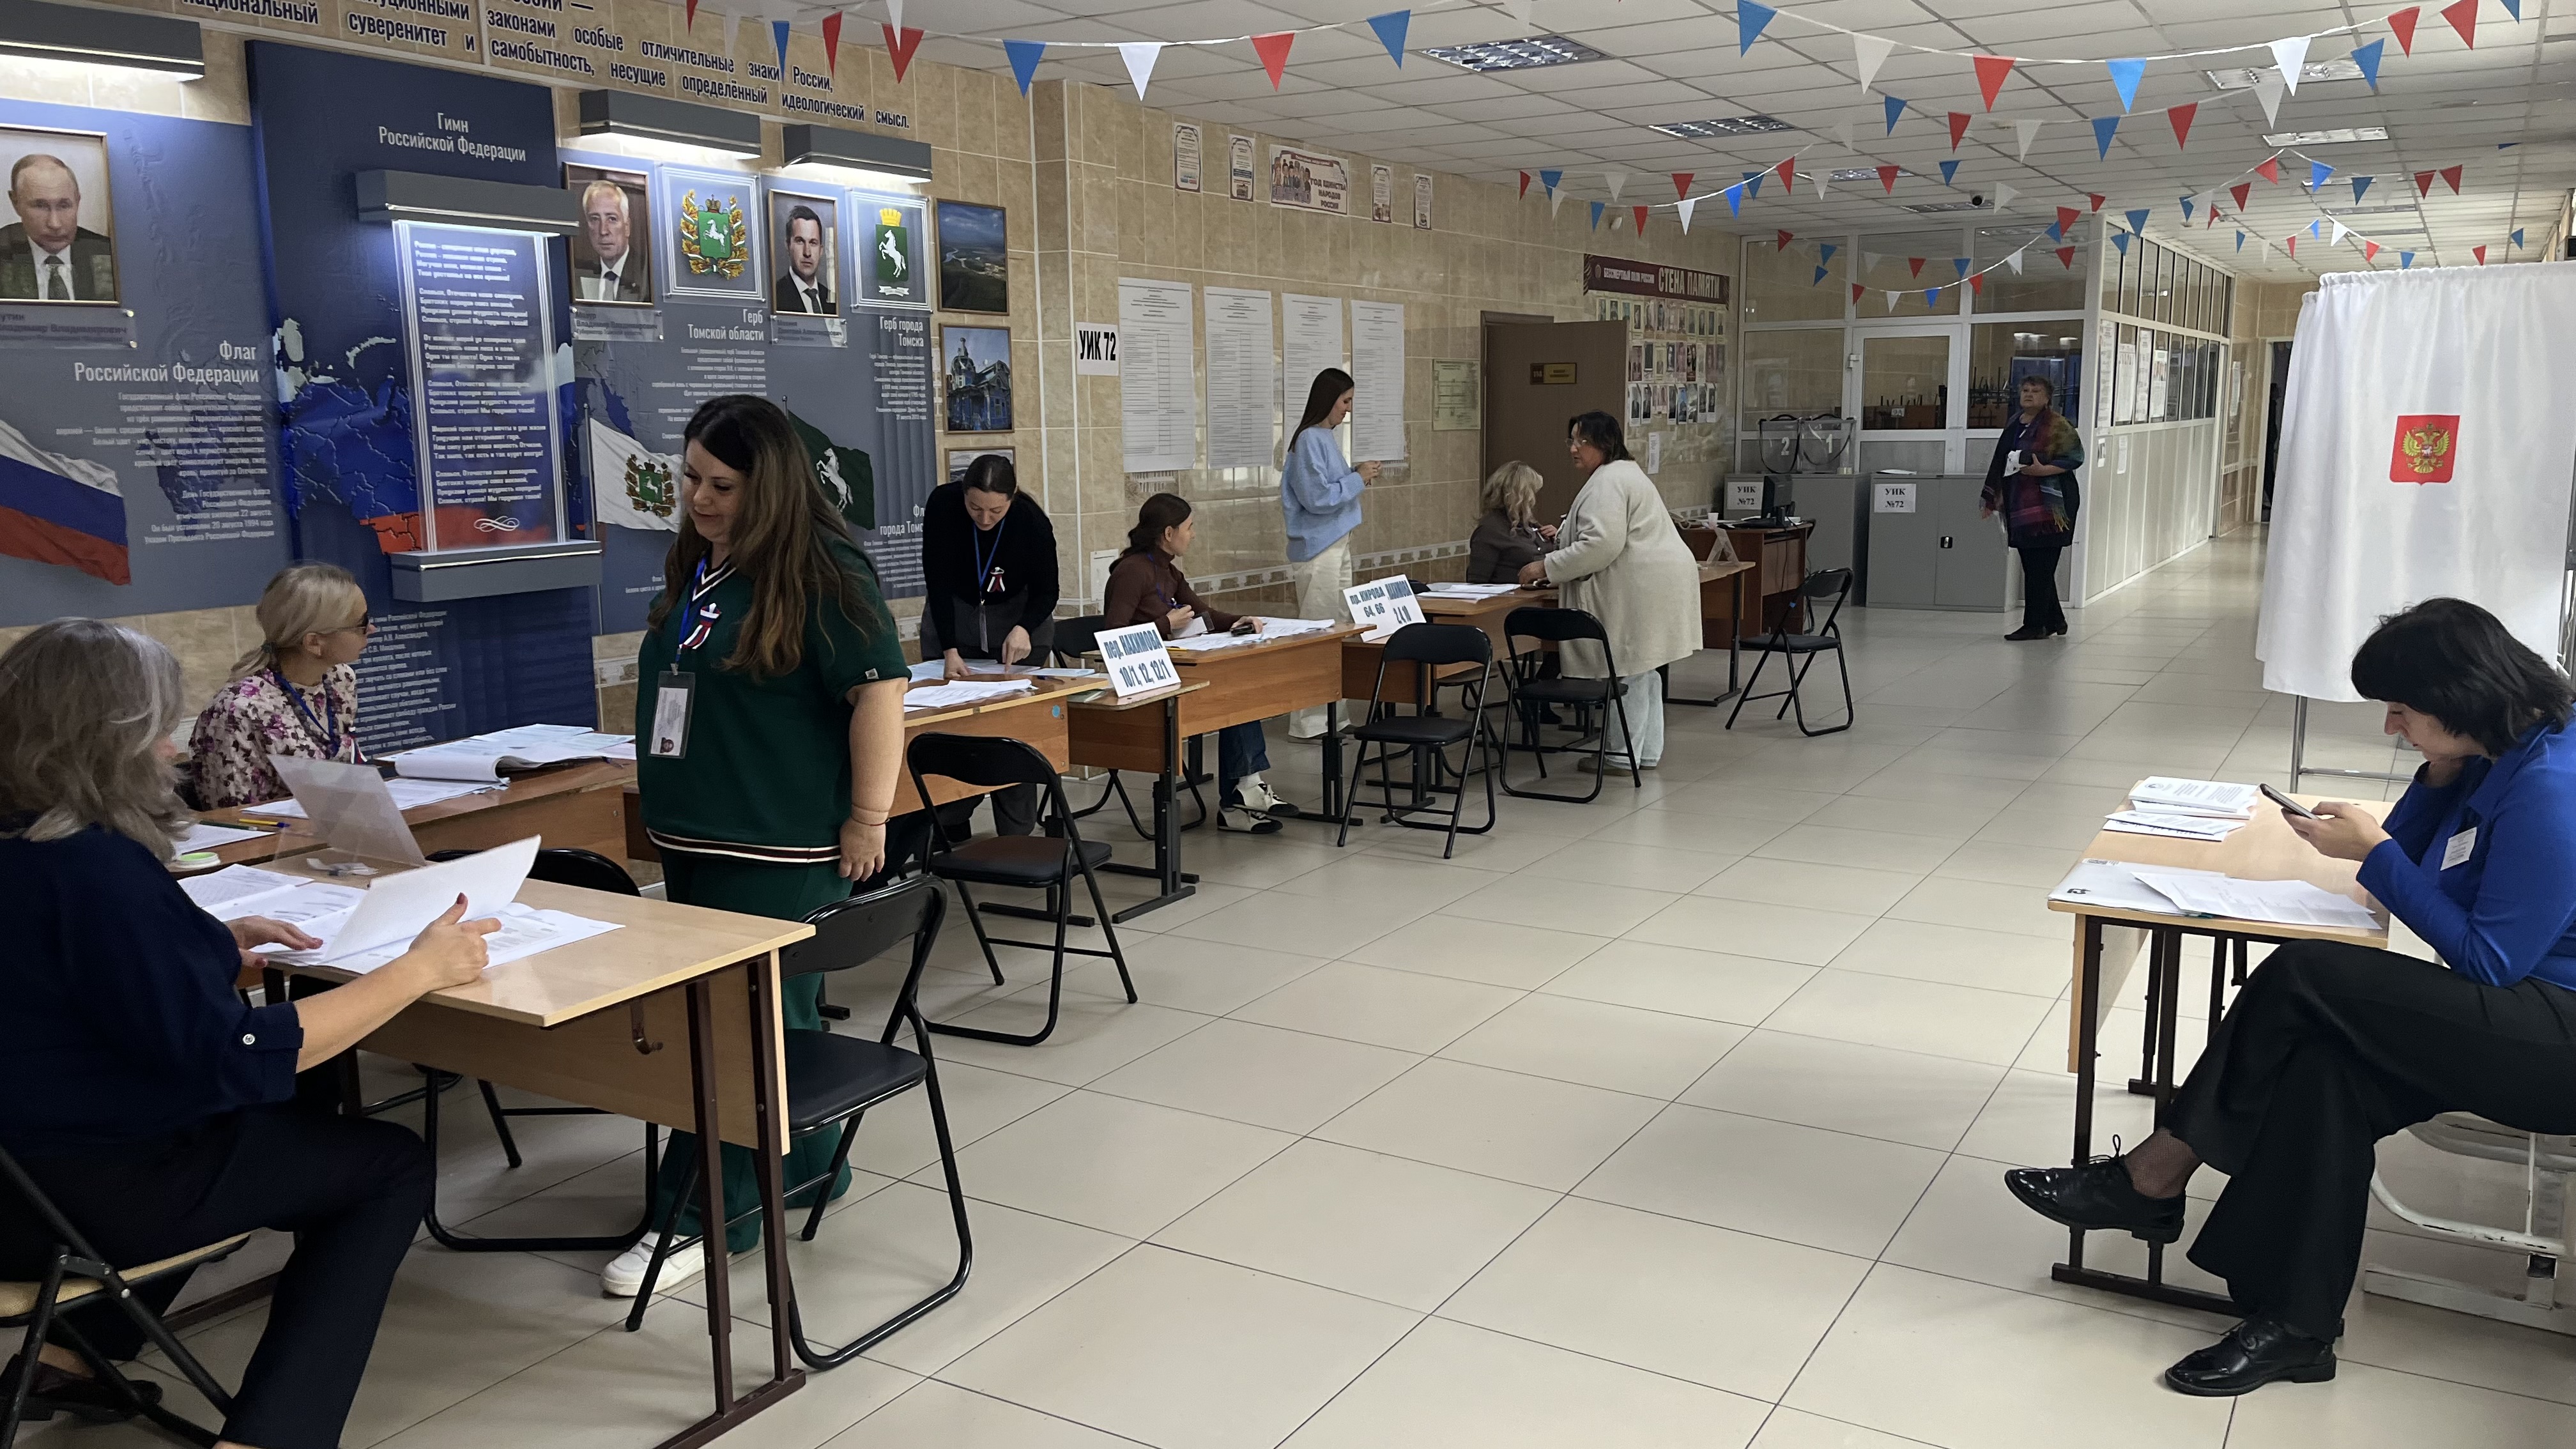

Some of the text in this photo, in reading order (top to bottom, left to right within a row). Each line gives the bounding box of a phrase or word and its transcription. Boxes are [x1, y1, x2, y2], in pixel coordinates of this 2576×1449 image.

[487, 10, 555, 38] законами
[574, 27, 624, 51] особые
[641, 40, 734, 73] отличительные
[748, 62, 779, 81] знаки
[793, 66, 832, 93] России,
[349, 13, 446, 46] суверенитет
[466, 35, 474, 50] и
[491, 40, 594, 75] самобытность,
[610, 62, 666, 88] несущие
[682, 77, 767, 104] определённый
[782, 93, 864, 121] идеологический
[875, 111, 909, 128] смысл.
[438, 112, 468, 133] Гимн
[379, 126, 526, 162] Российской Федерации
[1659, 267, 1719, 299] СТЕНА ПАМЯТИ
[743, 309, 763, 326] Герб
[880, 316, 923, 333] Герб города
[687, 324, 764, 341] Томской области
[898, 334, 924, 347] Томска
[220, 341, 256, 360] Флаг
[1079, 330, 1116, 360] УИК 72
[75, 362, 259, 384] Российской Федерации
[1781, 434, 1833, 456] 2 1
[913, 504, 925, 518] Фл
[880, 521, 923, 537] города Томс
[1359, 586, 1385, 602] КИРОВА
[1363, 603, 1385, 617] 64, 66
[1103, 629, 1163, 659] пер. НАХИМОВА
[1138, 663, 1154, 684] 12,
[1150, 659, 1171, 680] 12/1
